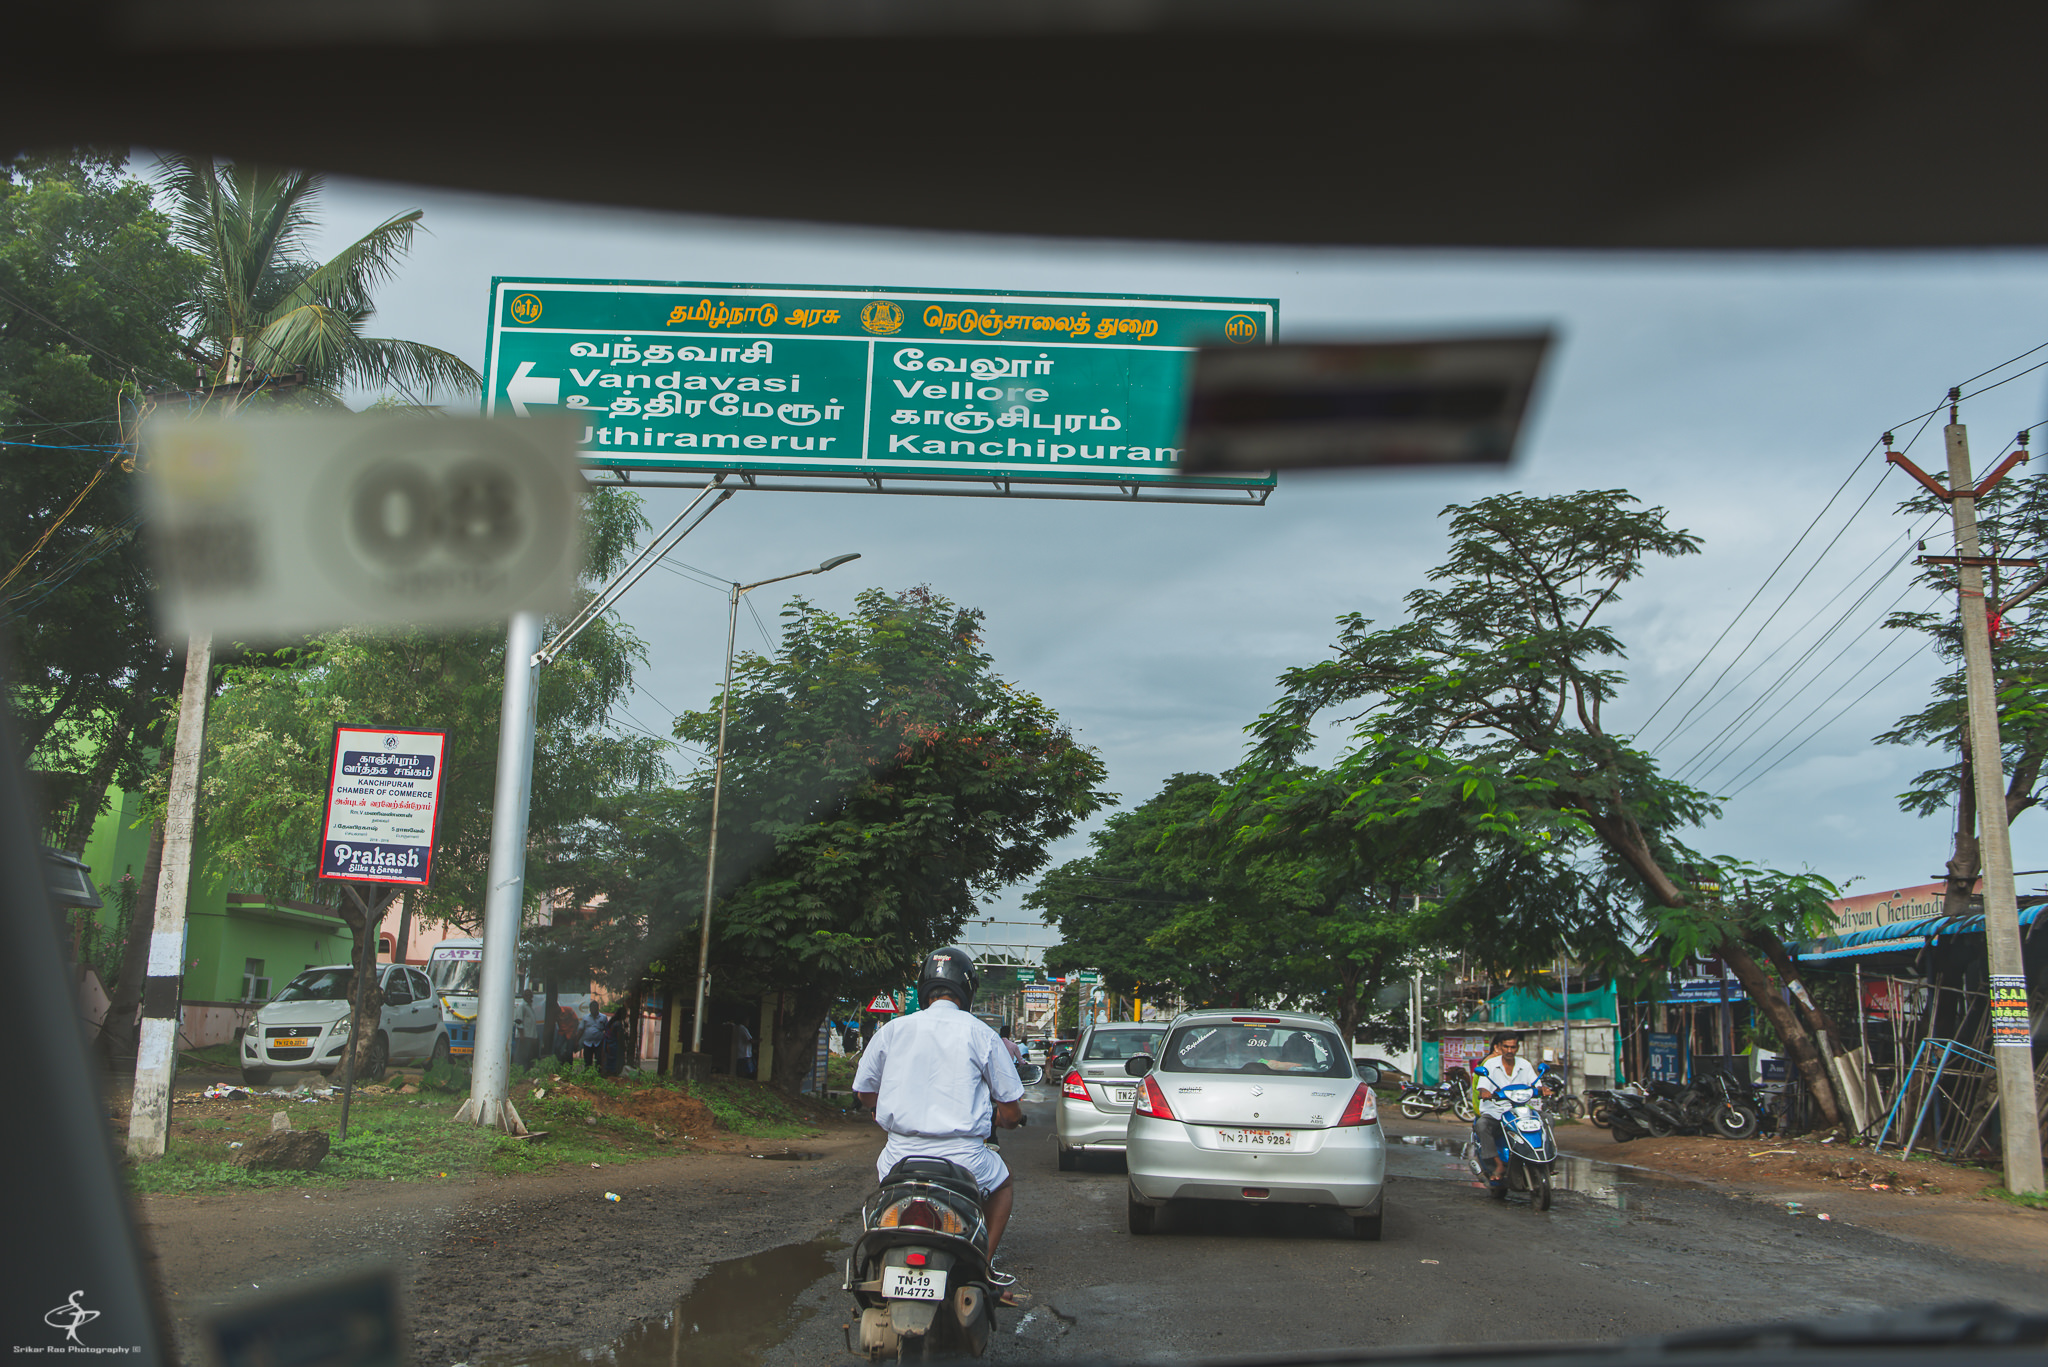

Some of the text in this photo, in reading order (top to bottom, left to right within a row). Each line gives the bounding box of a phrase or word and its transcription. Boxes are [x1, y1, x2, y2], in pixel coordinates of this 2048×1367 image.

[666, 299, 779, 329] தமிழ்நாடு
[784, 308, 841, 328] அரசு
[923, 305, 1091, 338] நெடுஞ்சாலைத்
[1094, 318, 1158, 341] துறை
[569, 336, 774, 366] வந்தவாசி
[893, 348, 1055, 380] வேலூர்
[569, 368, 801, 393] Vandavasi
[892, 379, 1050, 403] Vellore
[565, 389, 845, 427] உத்திரமேரூர்
[890, 404, 1122, 435] காஞ்சிபுரம்
[888, 434, 1187, 463] Kanchipuram
[359, 753, 420, 767] காஞ்சிபுரம்
[393, 765, 433, 777] சங்கம்
[337, 786, 433, 799] CHAMBER OF COMMERCE
[357, 778, 414, 789] KANCHIPURAM
[333, 843, 420, 868] Prakash
[348, 863, 403, 874] Silks & Sarees
[874, 1000, 891, 1009] SLOW
[1117, 1091, 1128, 1100] TN
[1221, 1133, 1291, 1145] TN 21 AS 9284
[898, 1275, 930, 1287] TN-19
[894, 1286, 935, 1298] M-4773
